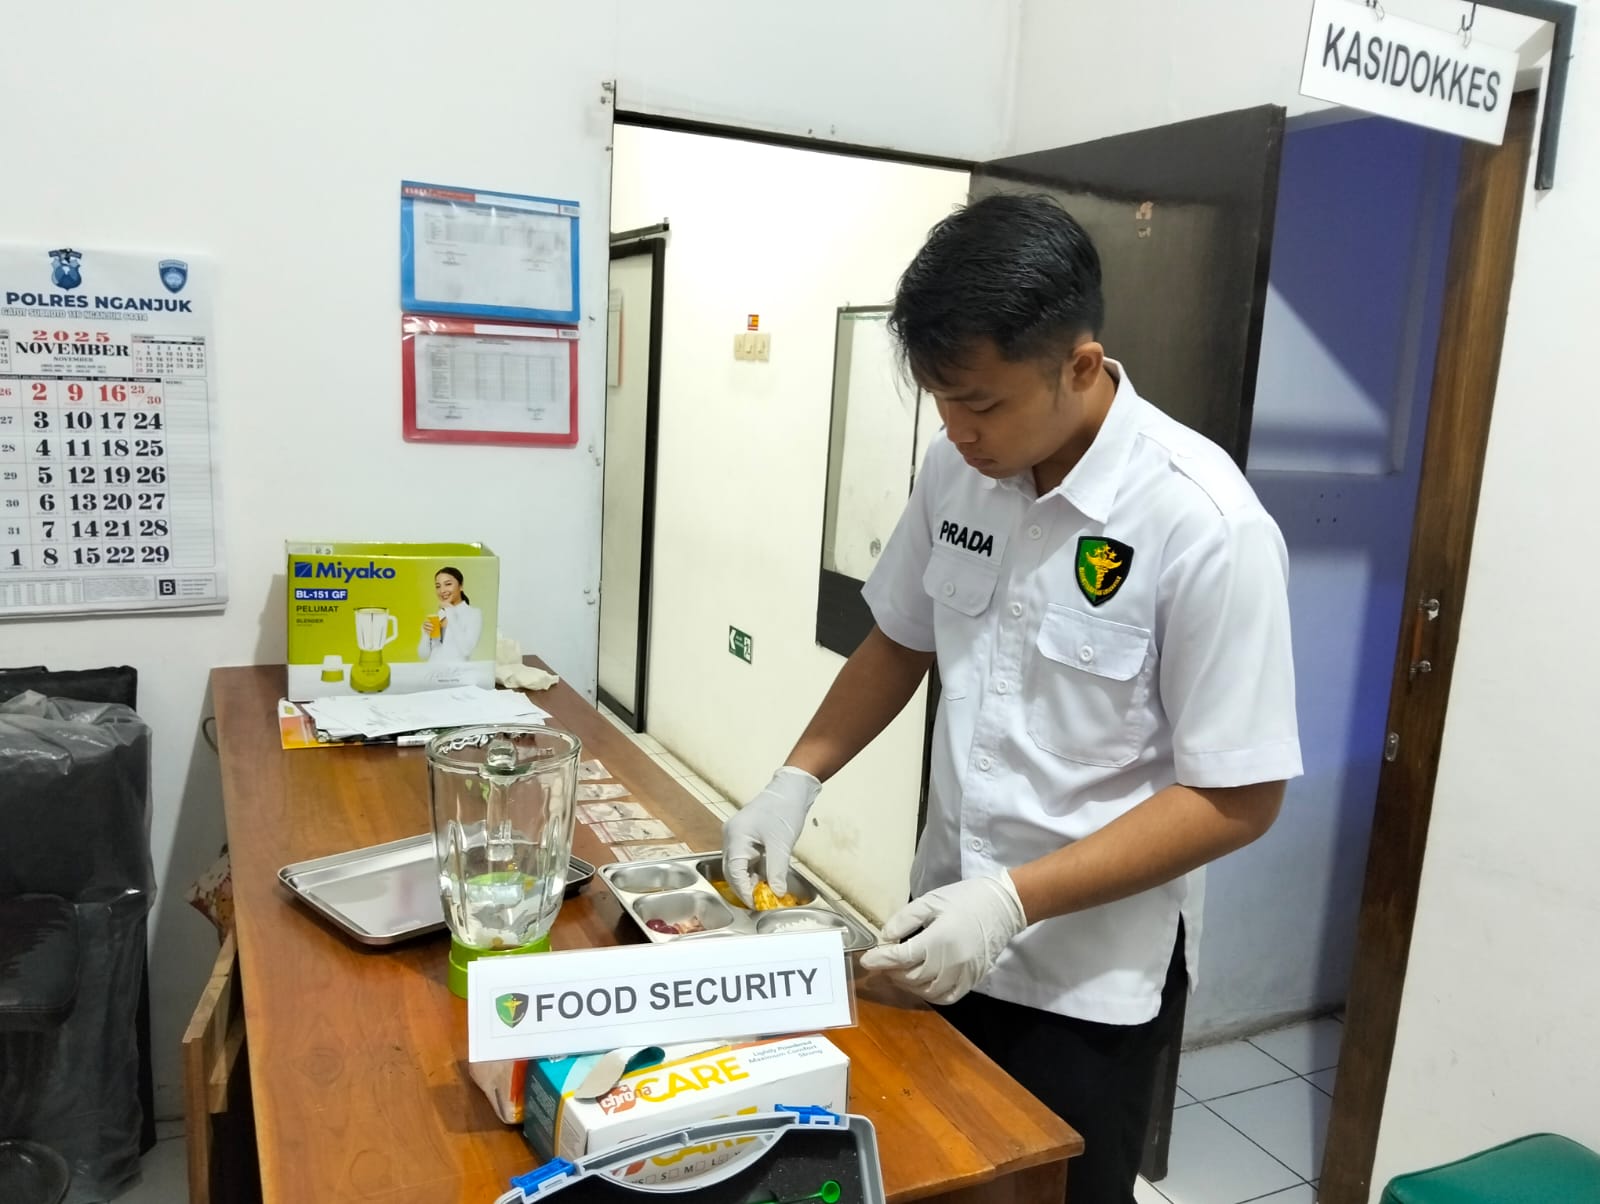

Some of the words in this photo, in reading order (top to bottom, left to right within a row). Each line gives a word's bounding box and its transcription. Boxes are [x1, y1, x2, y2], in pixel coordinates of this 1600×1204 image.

[1322, 22, 1501, 112] KASIDOKKES
[6, 292, 89, 308] POLRES
[95, 296, 193, 313] NGANJUK
[32, 330, 110, 343] 2025
[16, 341, 130, 356] NOVEMBER
[0, 388, 12, 397] 26
[32, 383, 48, 401] 2
[67, 384, 83, 402] 9
[99, 384, 126, 402] 16
[131, 386, 145, 394] 23
[147, 396, 161, 404] 30
[0, 416, 13, 425] 27
[34, 411, 49, 429] 3
[65, 412, 93, 429] 10
[101, 412, 126, 429] 17
[134, 413, 163, 430] 24
[1, 444, 16, 452] 28
[36, 439, 50, 457] 4
[66, 440, 92, 457] 11
[102, 440, 129, 457] 18
[135, 440, 164, 457] 25
[4, 472, 17, 480] 29
[38, 467, 53, 484] 5
[68, 467, 95, 484] 12
[104, 467, 131, 483] 19
[136, 467, 166, 483] 26
[40, 494, 55, 512] 6
[70, 494, 97, 511] 13
[103, 494, 132, 510] 20
[138, 494, 165, 510] 27
[8, 527, 20, 535] 31
[42, 521, 55, 538] 7
[72, 521, 99, 537] 14
[104, 520, 132, 537] 21
[140, 520, 168, 536] 28
[939, 520, 993, 557] PRADA
[11, 549, 23, 566] 1
[43, 548, 58, 565] 8
[73, 548, 100, 564] 15
[106, 546, 135, 563] 22
[142, 546, 170, 563] 29
[316, 561, 396, 583] Miyako
[296, 590, 329, 599] BL-151
[332, 591, 346, 599] GF
[296, 605, 339, 613] PELUMAT
[536, 986, 637, 1022] FOOD
[649, 968, 818, 1010] SECURITY
[748, 1052, 786, 1063] Maximum
[787, 1044, 817, 1055] Comfort
[753, 1047, 777, 1057] Lightly
[777, 1040, 812, 1051] Powdered
[798, 1049, 823, 1058] Strong
[635, 1056, 749, 1102] CARE
[684, 1166, 693, 1174] M
